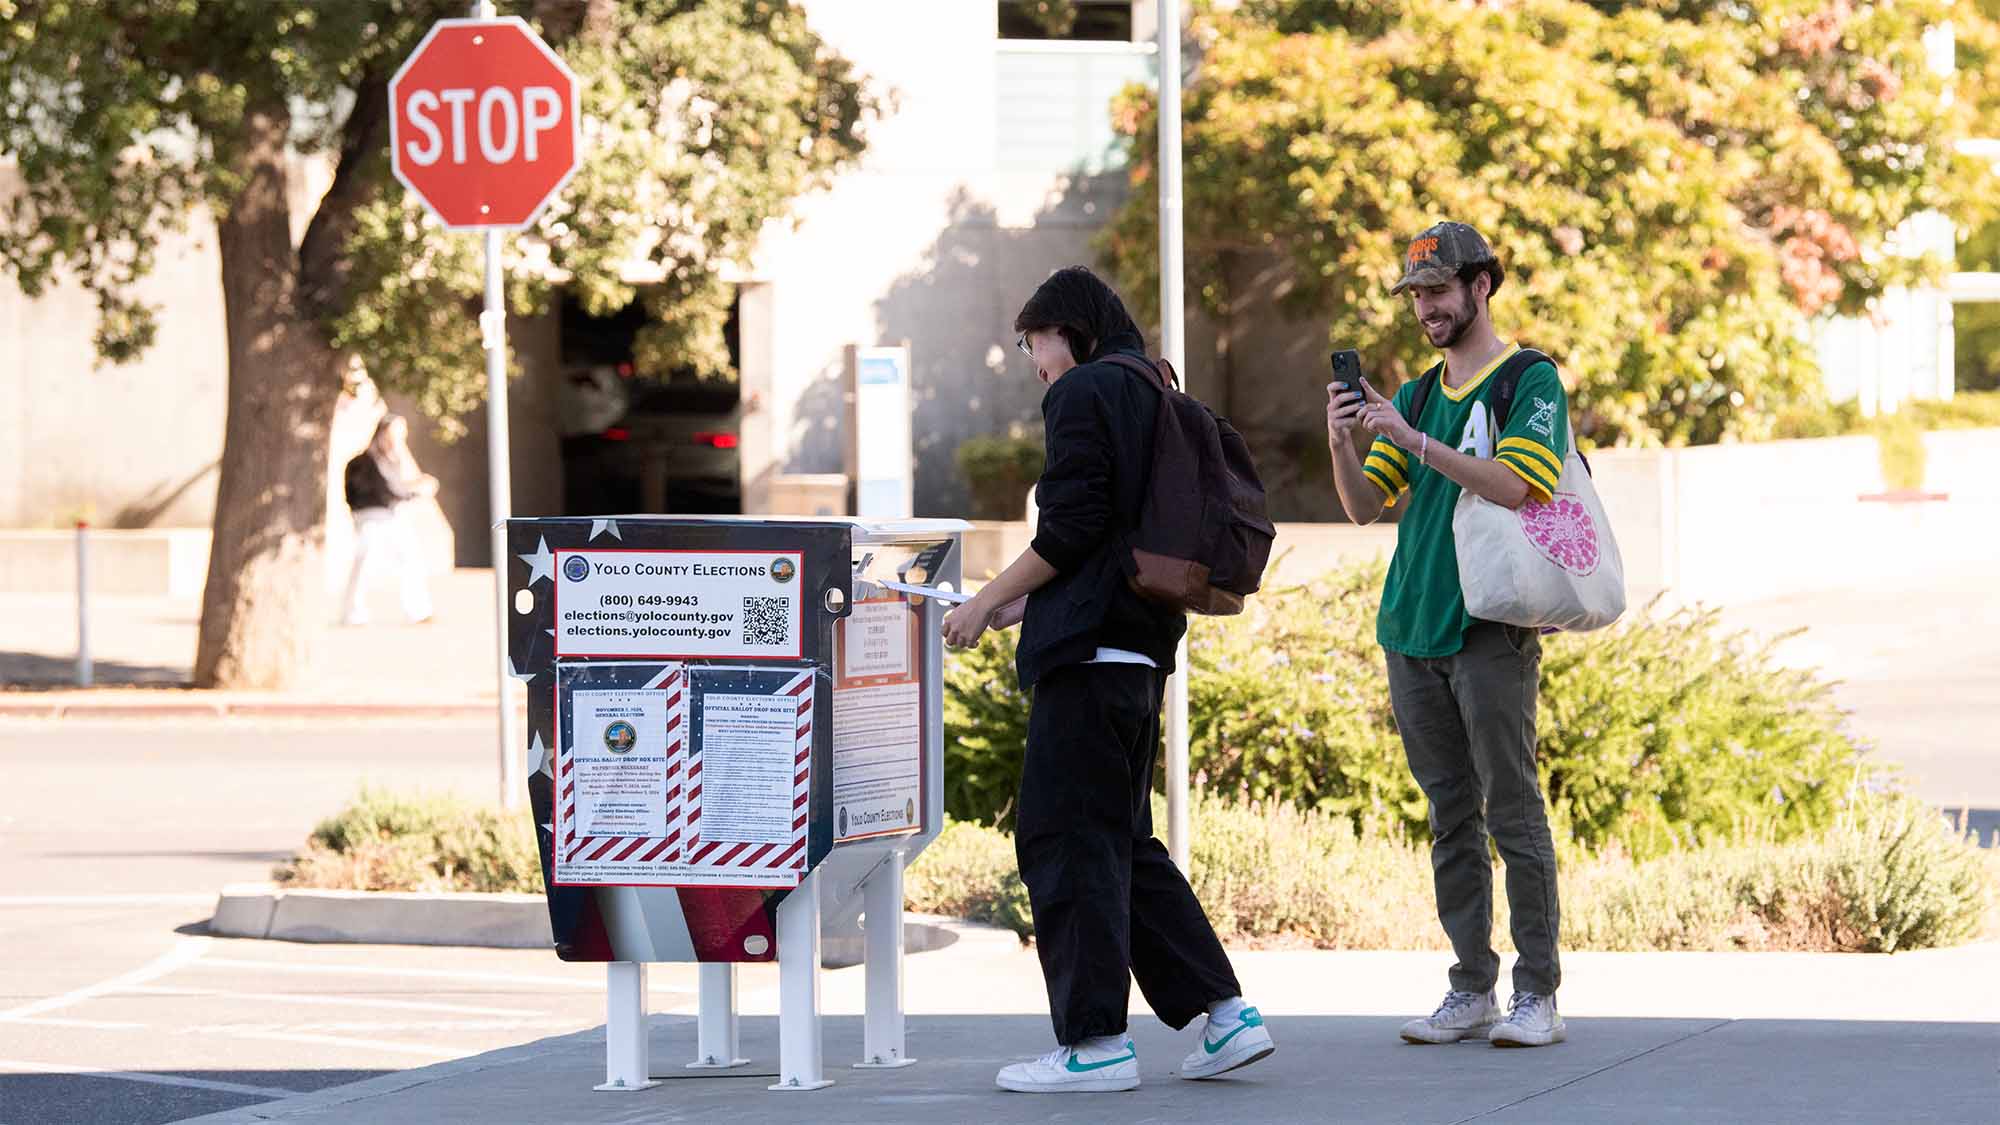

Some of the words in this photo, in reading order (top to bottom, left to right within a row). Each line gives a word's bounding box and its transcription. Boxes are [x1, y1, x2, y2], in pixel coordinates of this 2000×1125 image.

[406, 86, 562, 166] STOP
[594, 563, 630, 576] YOLO
[634, 563, 689, 576] COUNTY
[693, 564, 766, 577] ELECTIONS
[600, 595, 634, 608] (800)
[638, 595, 698, 606] 649-9943
[564, 610, 734, 623] elections@yolocounty.gov
[566, 626, 732, 638] elections.yolocounty.gov
